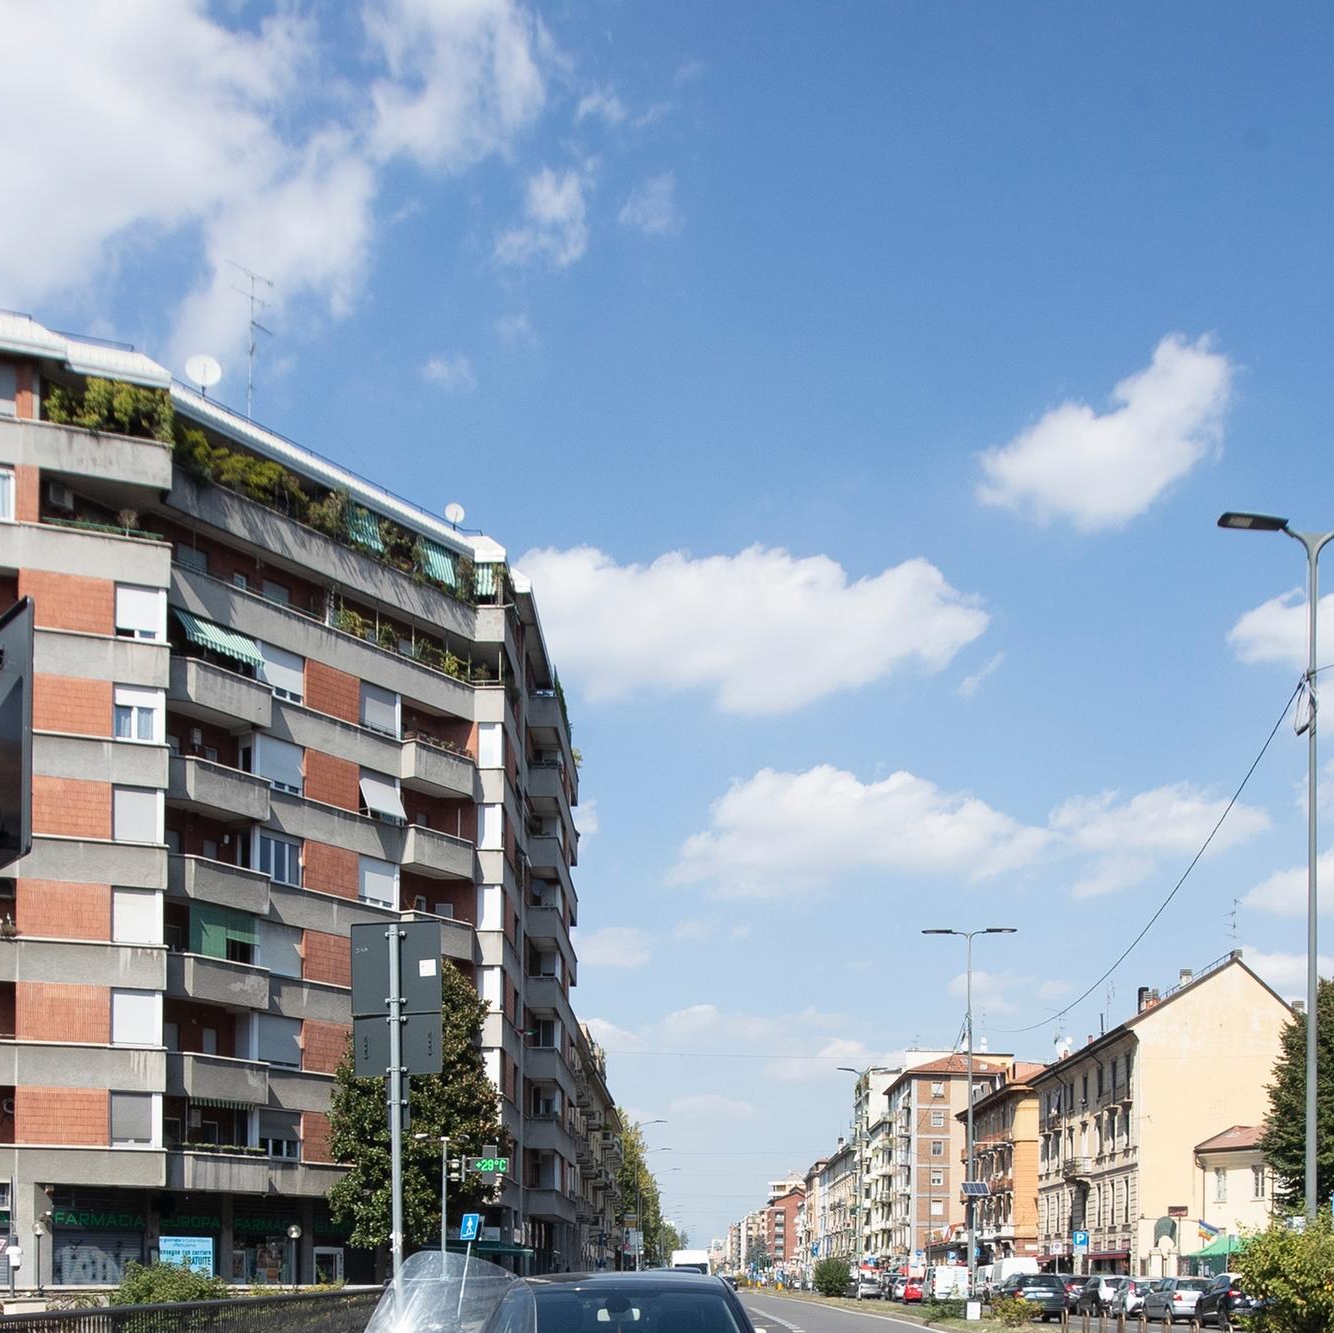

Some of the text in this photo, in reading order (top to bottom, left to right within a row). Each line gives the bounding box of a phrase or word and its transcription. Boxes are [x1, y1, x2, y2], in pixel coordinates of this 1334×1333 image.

[475, 1159, 507, 1171] +29°C
[53, 1210, 221, 1229] FARMACIA EUROPA
[234, 1218, 301, 1233] FARMAC
[184, 1256, 211, 1265] RATUITE
